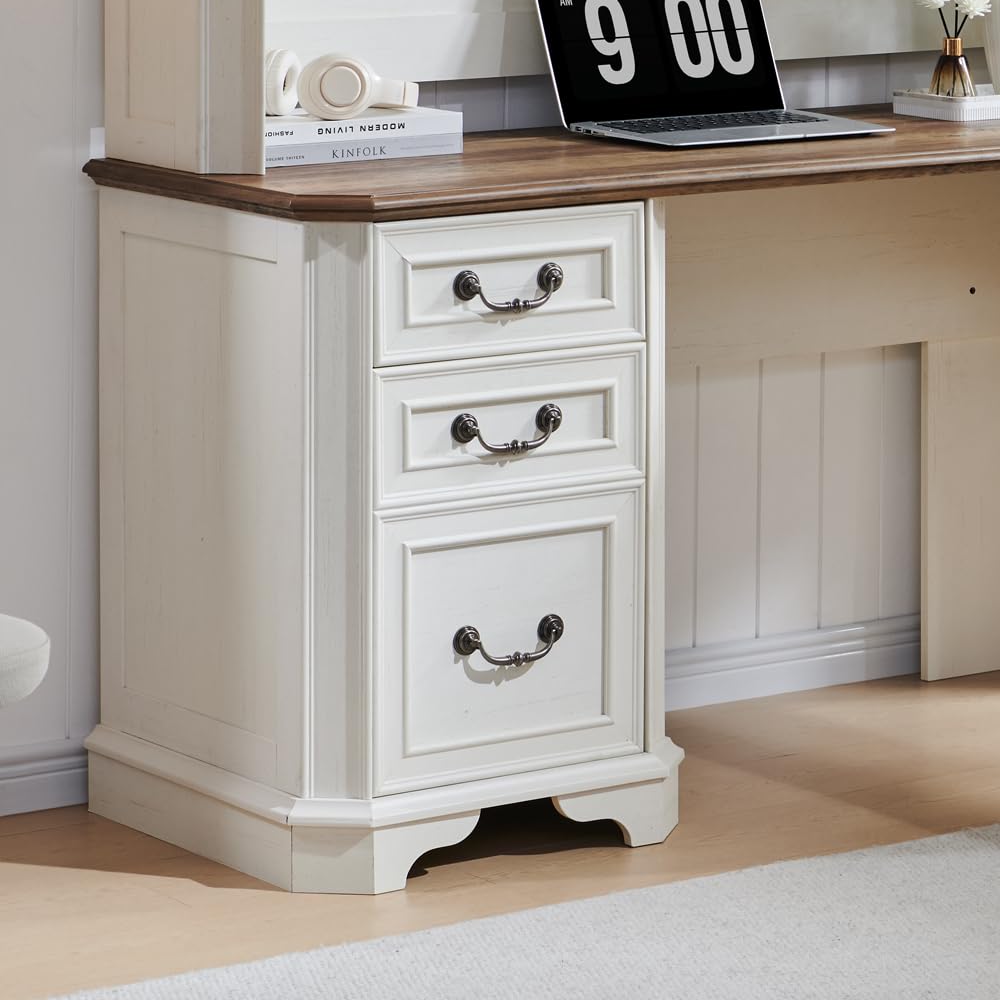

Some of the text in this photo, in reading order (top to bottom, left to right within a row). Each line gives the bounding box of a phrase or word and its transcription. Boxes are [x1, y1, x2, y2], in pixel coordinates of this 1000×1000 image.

[317, 122, 406, 135] MODERN LIVING
[332, 145, 387, 159] KINFOLK
